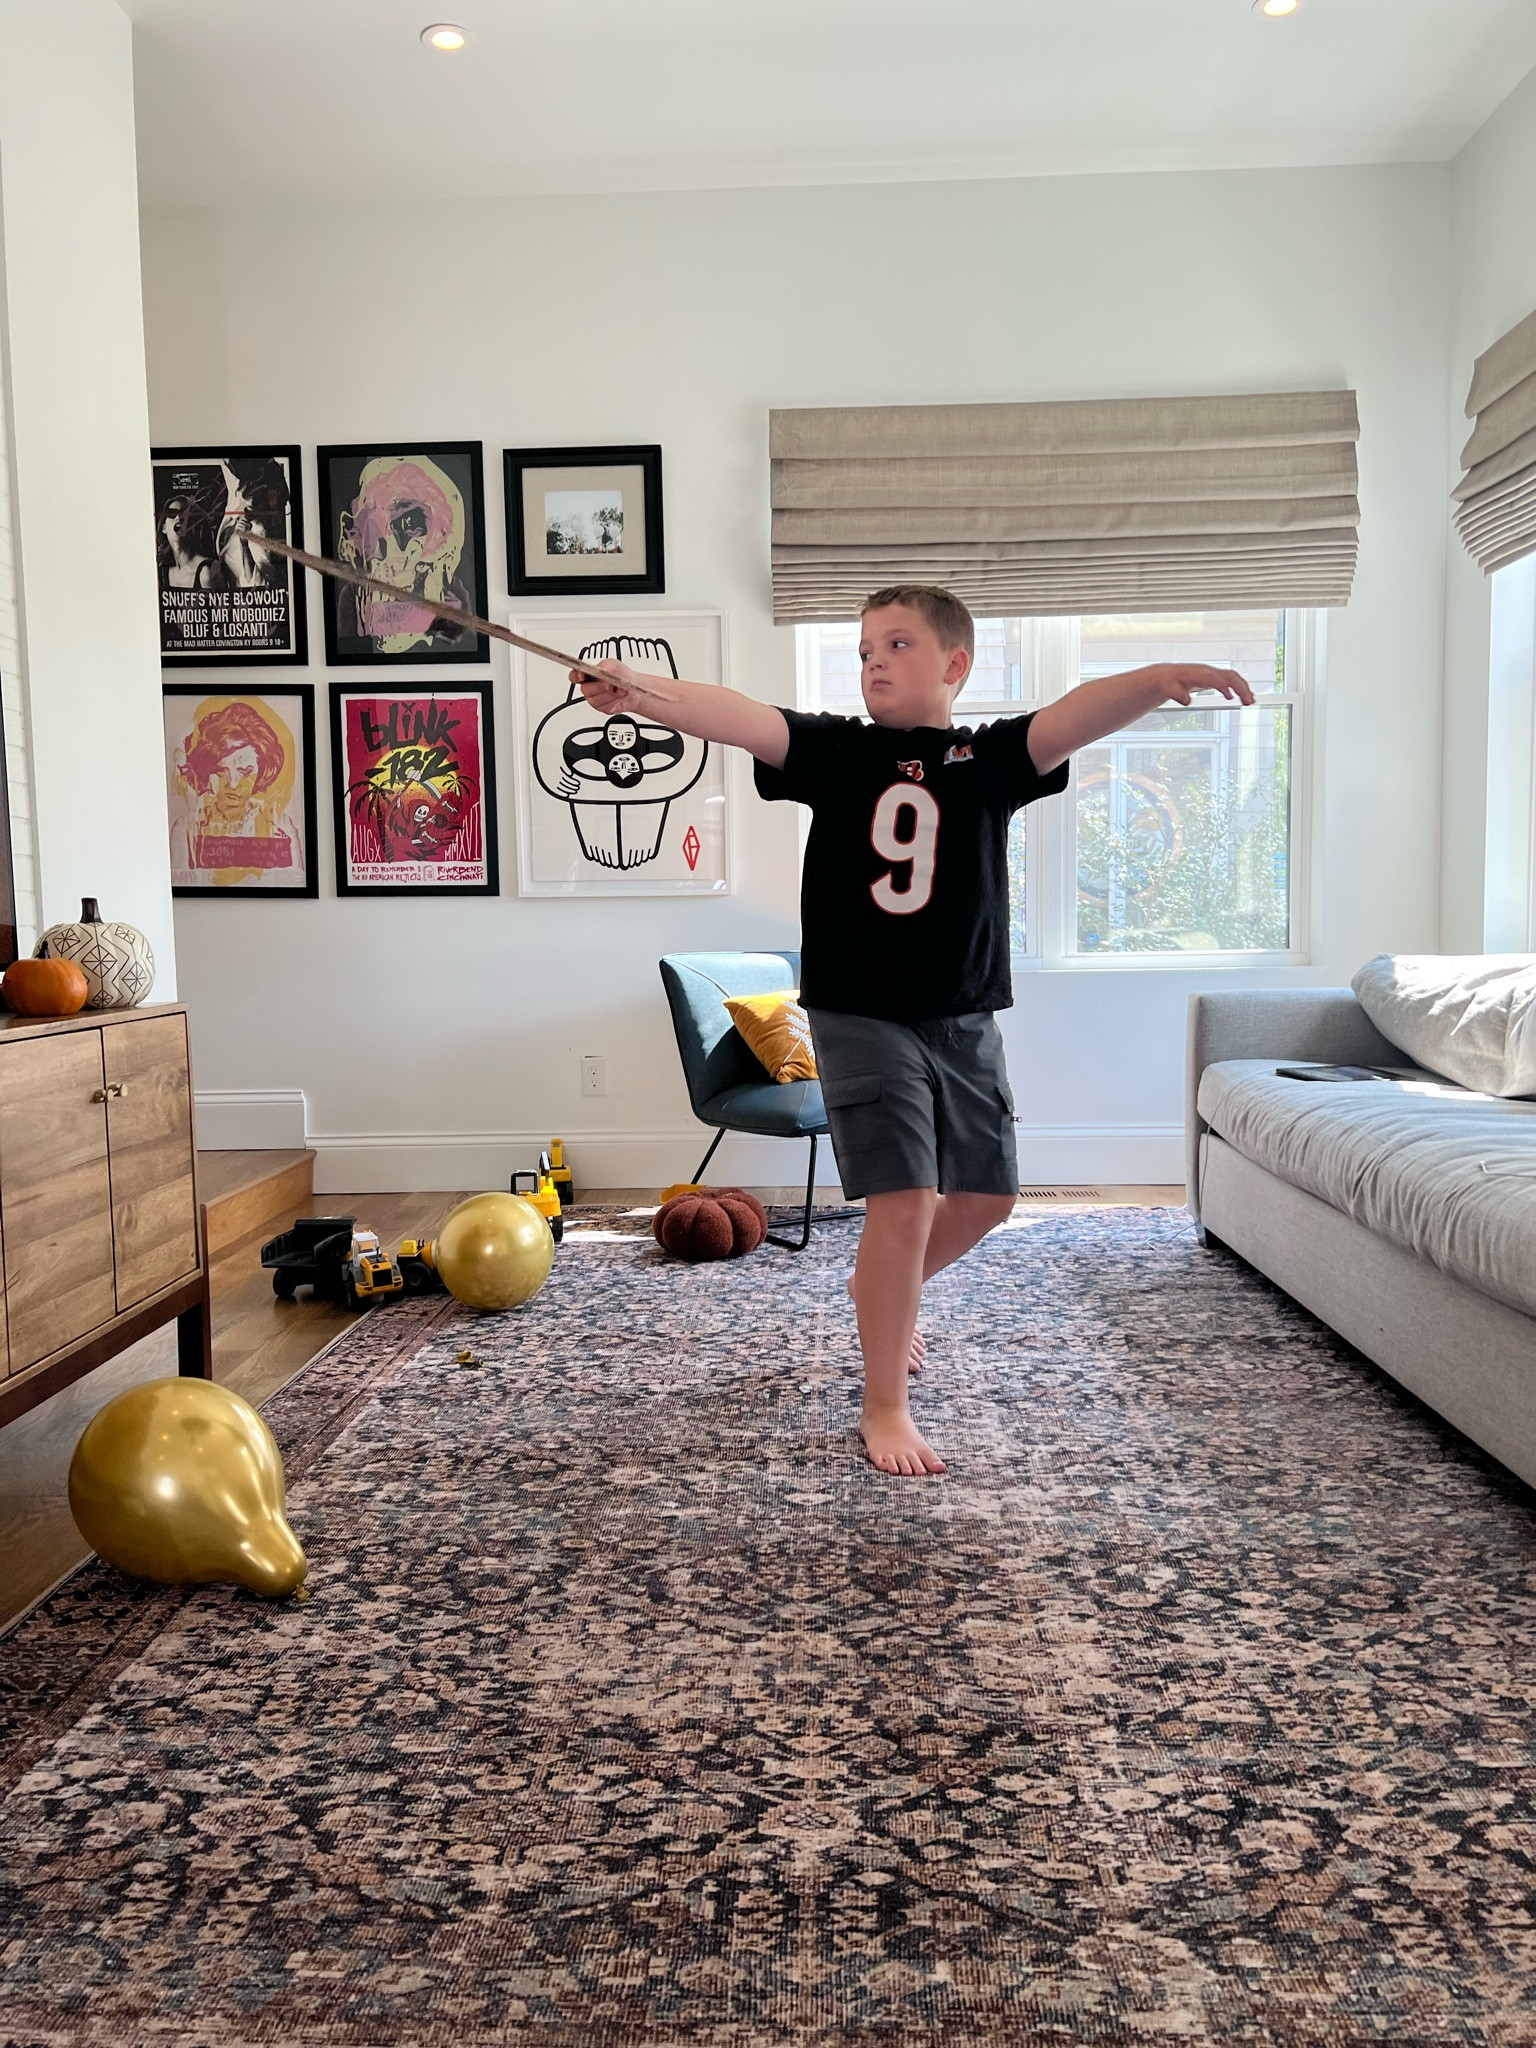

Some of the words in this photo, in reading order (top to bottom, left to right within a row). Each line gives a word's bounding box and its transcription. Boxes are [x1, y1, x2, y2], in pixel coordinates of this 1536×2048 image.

[162, 591, 205, 606] SNUFF'S
[209, 593, 229, 606] NYE
[234, 589, 285, 605] BLOWOUT
[165, 609, 208, 623] FAMOUS
[212, 609, 229, 623] MR
[233, 608, 285, 622] NOBODIEZ
[183, 624, 209, 638] BLUF
[213, 624, 220, 637] &
[224, 623, 268, 637] LOSANTI
[870, 782, 940, 915] 9
